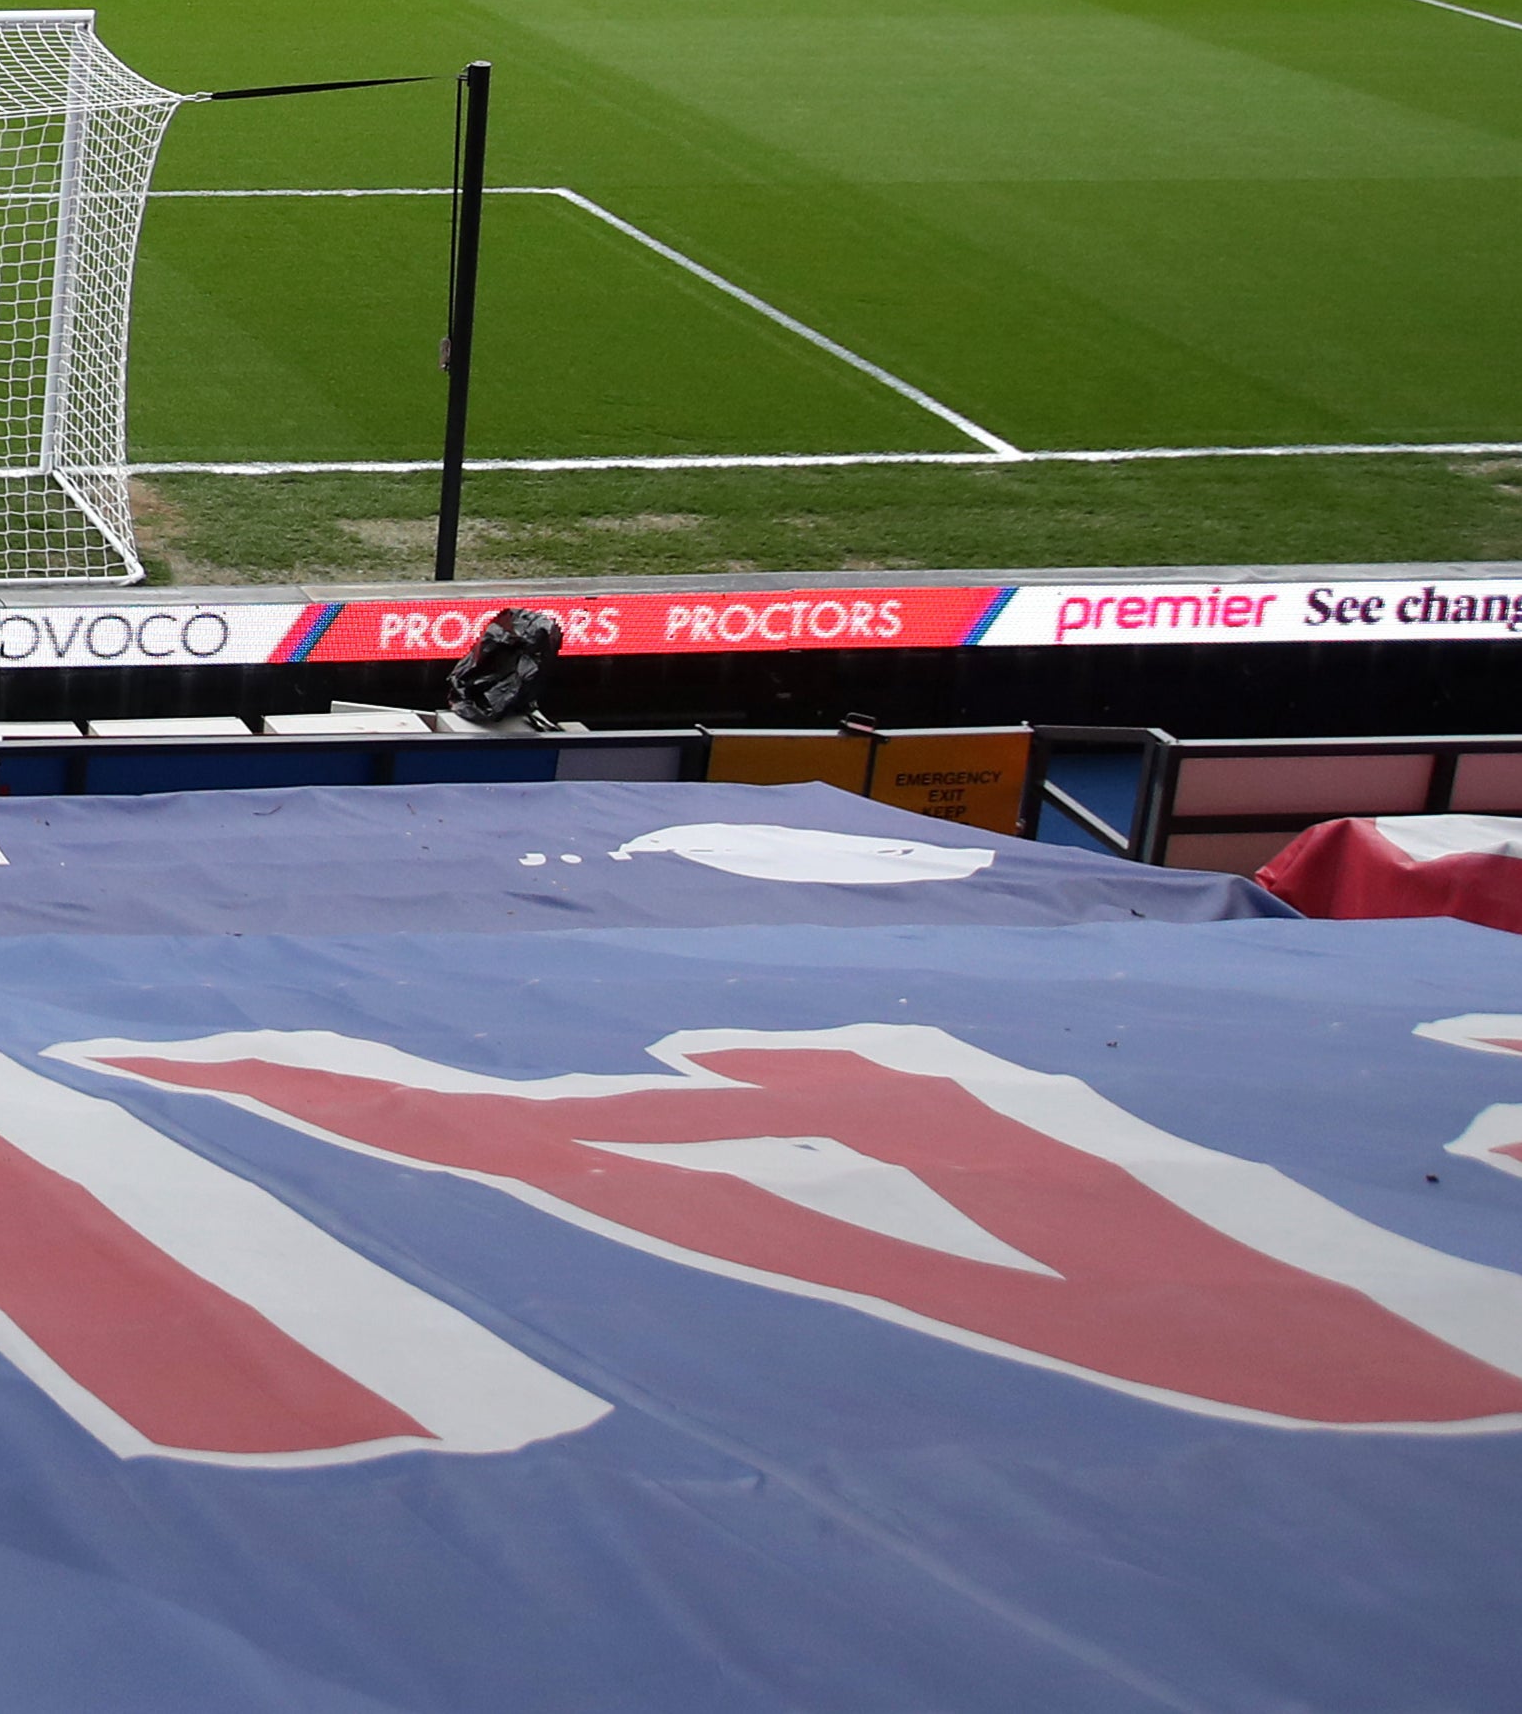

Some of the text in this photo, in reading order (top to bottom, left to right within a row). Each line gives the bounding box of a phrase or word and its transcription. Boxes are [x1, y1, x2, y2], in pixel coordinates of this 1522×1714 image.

[665, 598, 904, 643] PROCTORS
[1054, 585, 1278, 643] premier
[1304, 587, 1385, 626] See
[895, 770, 1002, 787] EMERGENCY
[927, 788, 966, 803] EXIT
